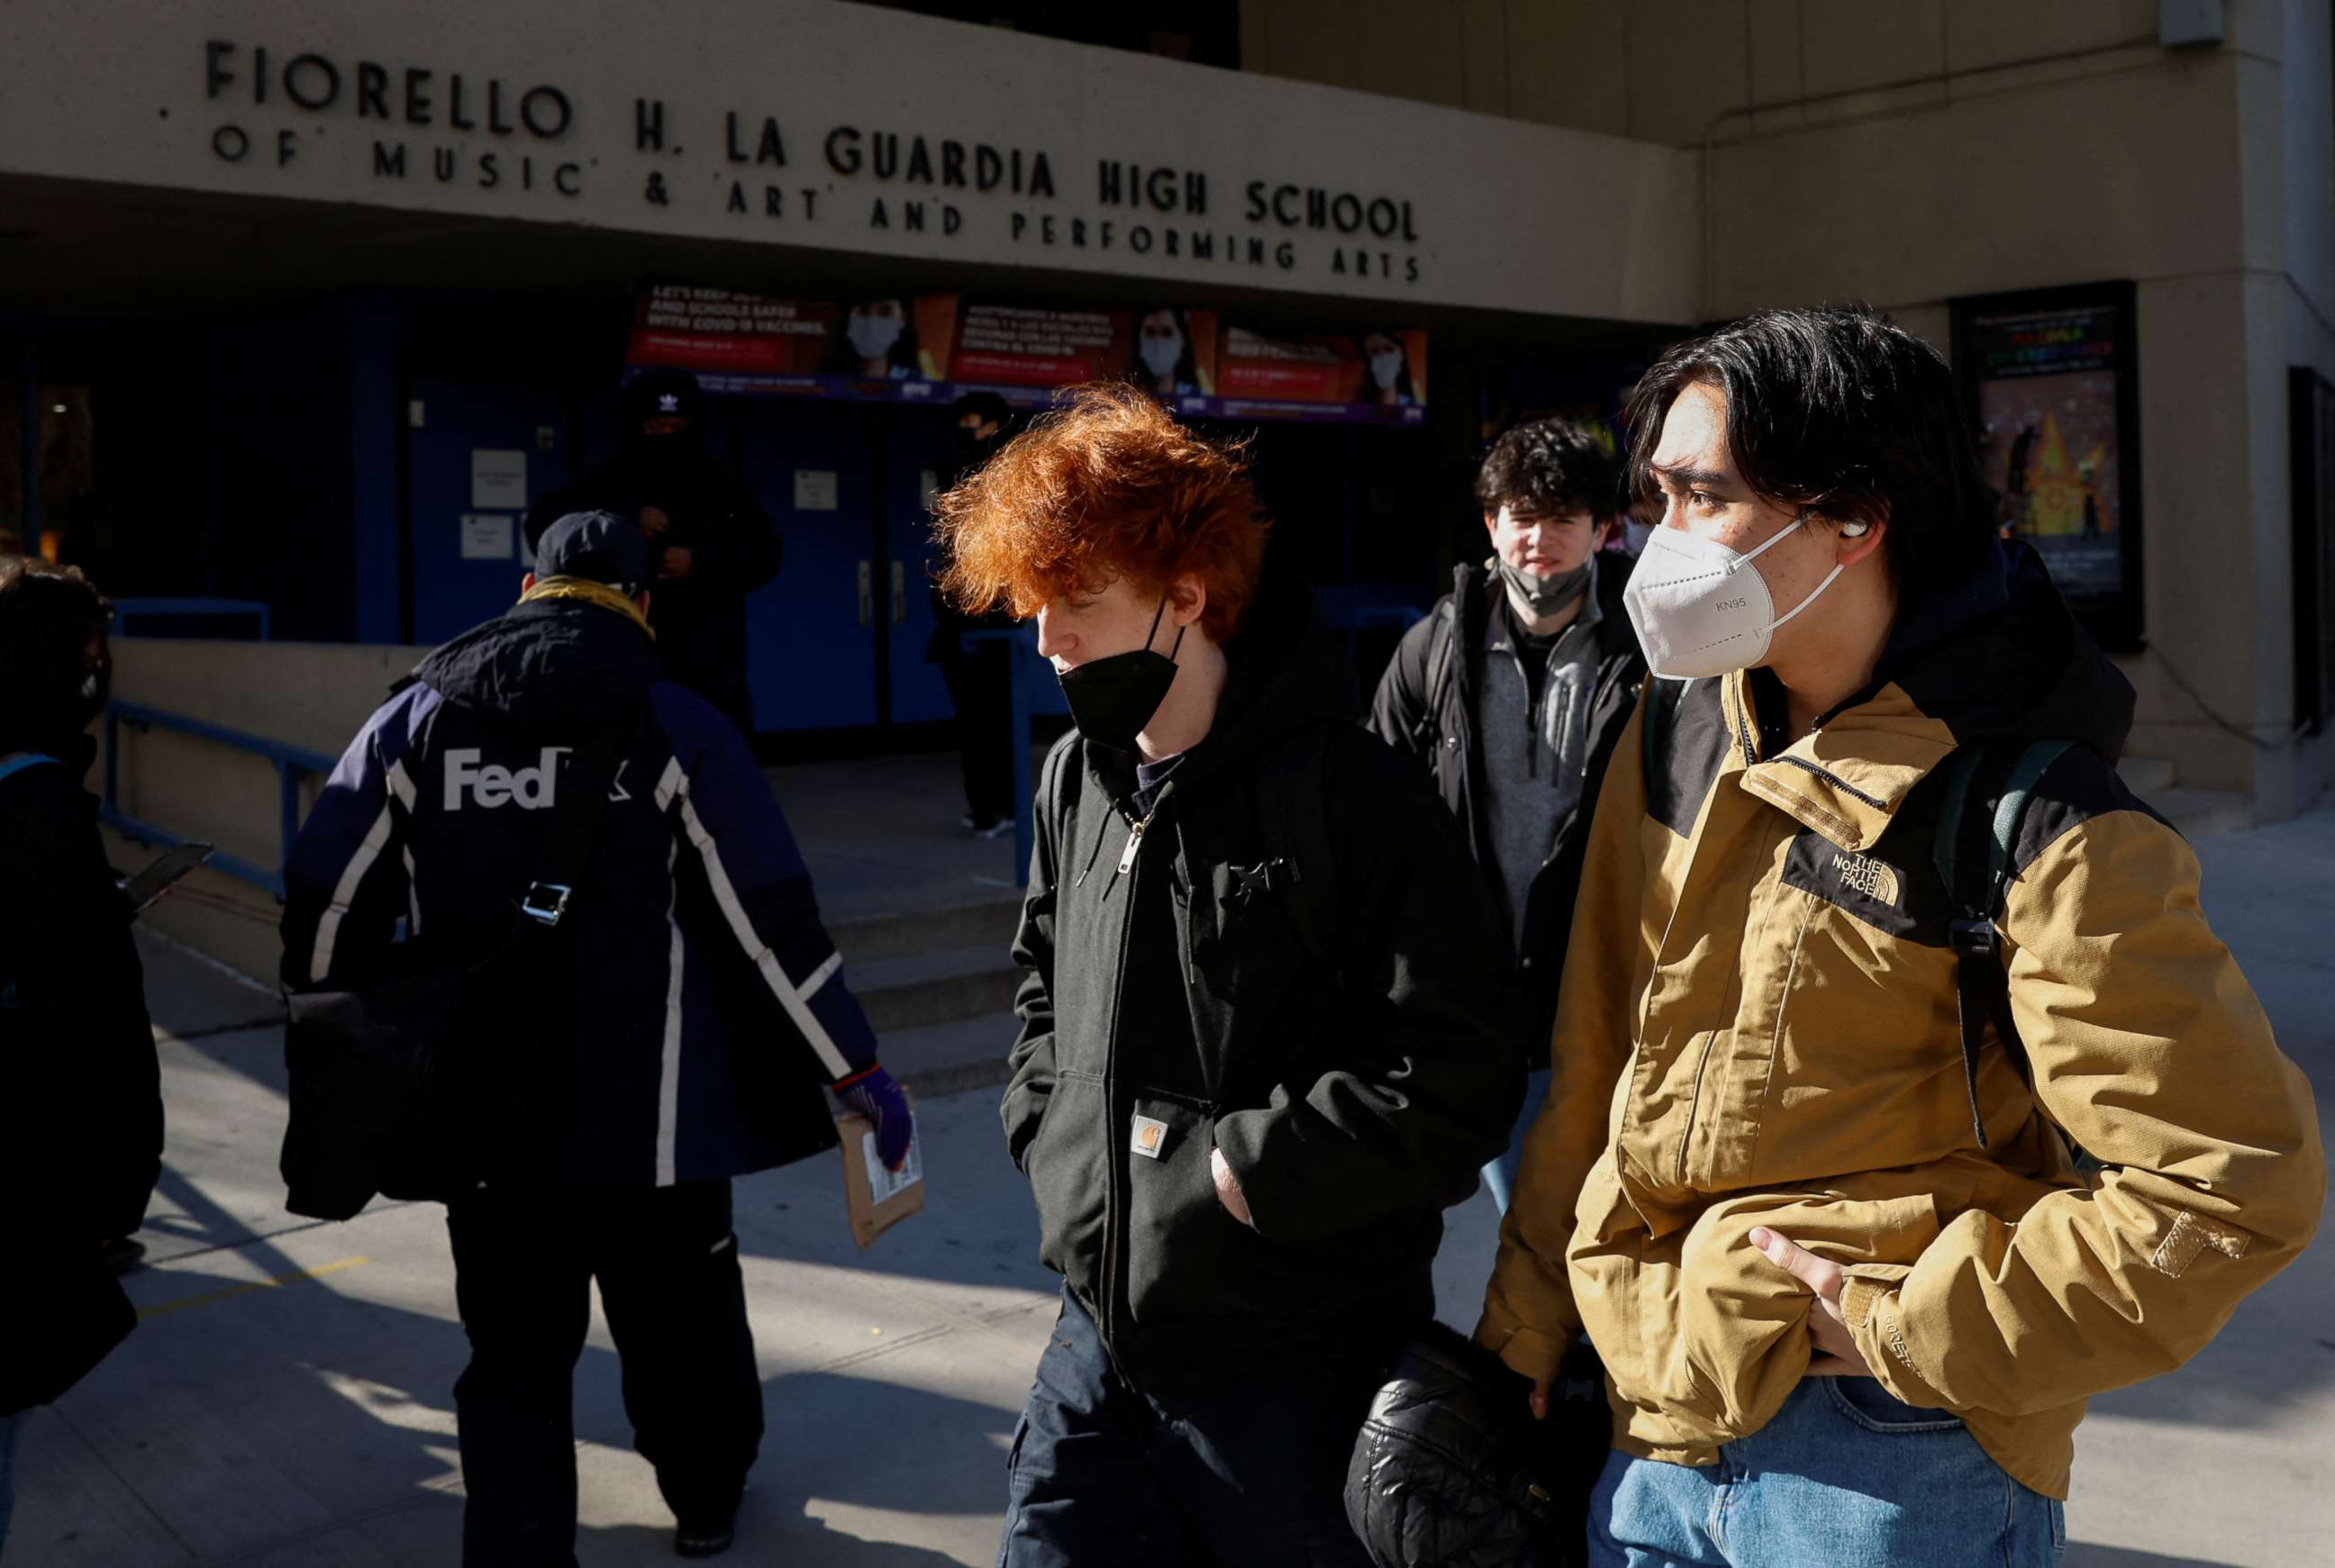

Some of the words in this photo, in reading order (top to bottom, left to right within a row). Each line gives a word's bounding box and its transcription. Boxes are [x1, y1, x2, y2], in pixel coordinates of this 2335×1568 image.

[205, 40, 574, 140] FIORELLO
[636, 98, 683, 156] H.
[725, 111, 787, 168] LA
[823, 125, 1056, 199] GUARDIA
[1098, 159, 1208, 216] HIGH
[1245, 180, 1420, 245] SCHOOL
[210, 124, 297, 168] OF
[372, 140, 581, 197] MUSIC
[643, 171, 670, 207] &
[726, 180, 819, 221] ART
[869, 197, 963, 236] AND
[1011, 211, 1295, 269] PERFORMING
[1331, 249, 1420, 284] ARTS
[1715, 597, 1747, 613] KN95
[1832, 853, 1879, 885] NORTH
[1856, 853, 1883, 875] THE
[1840, 871, 1876, 896] FACE
